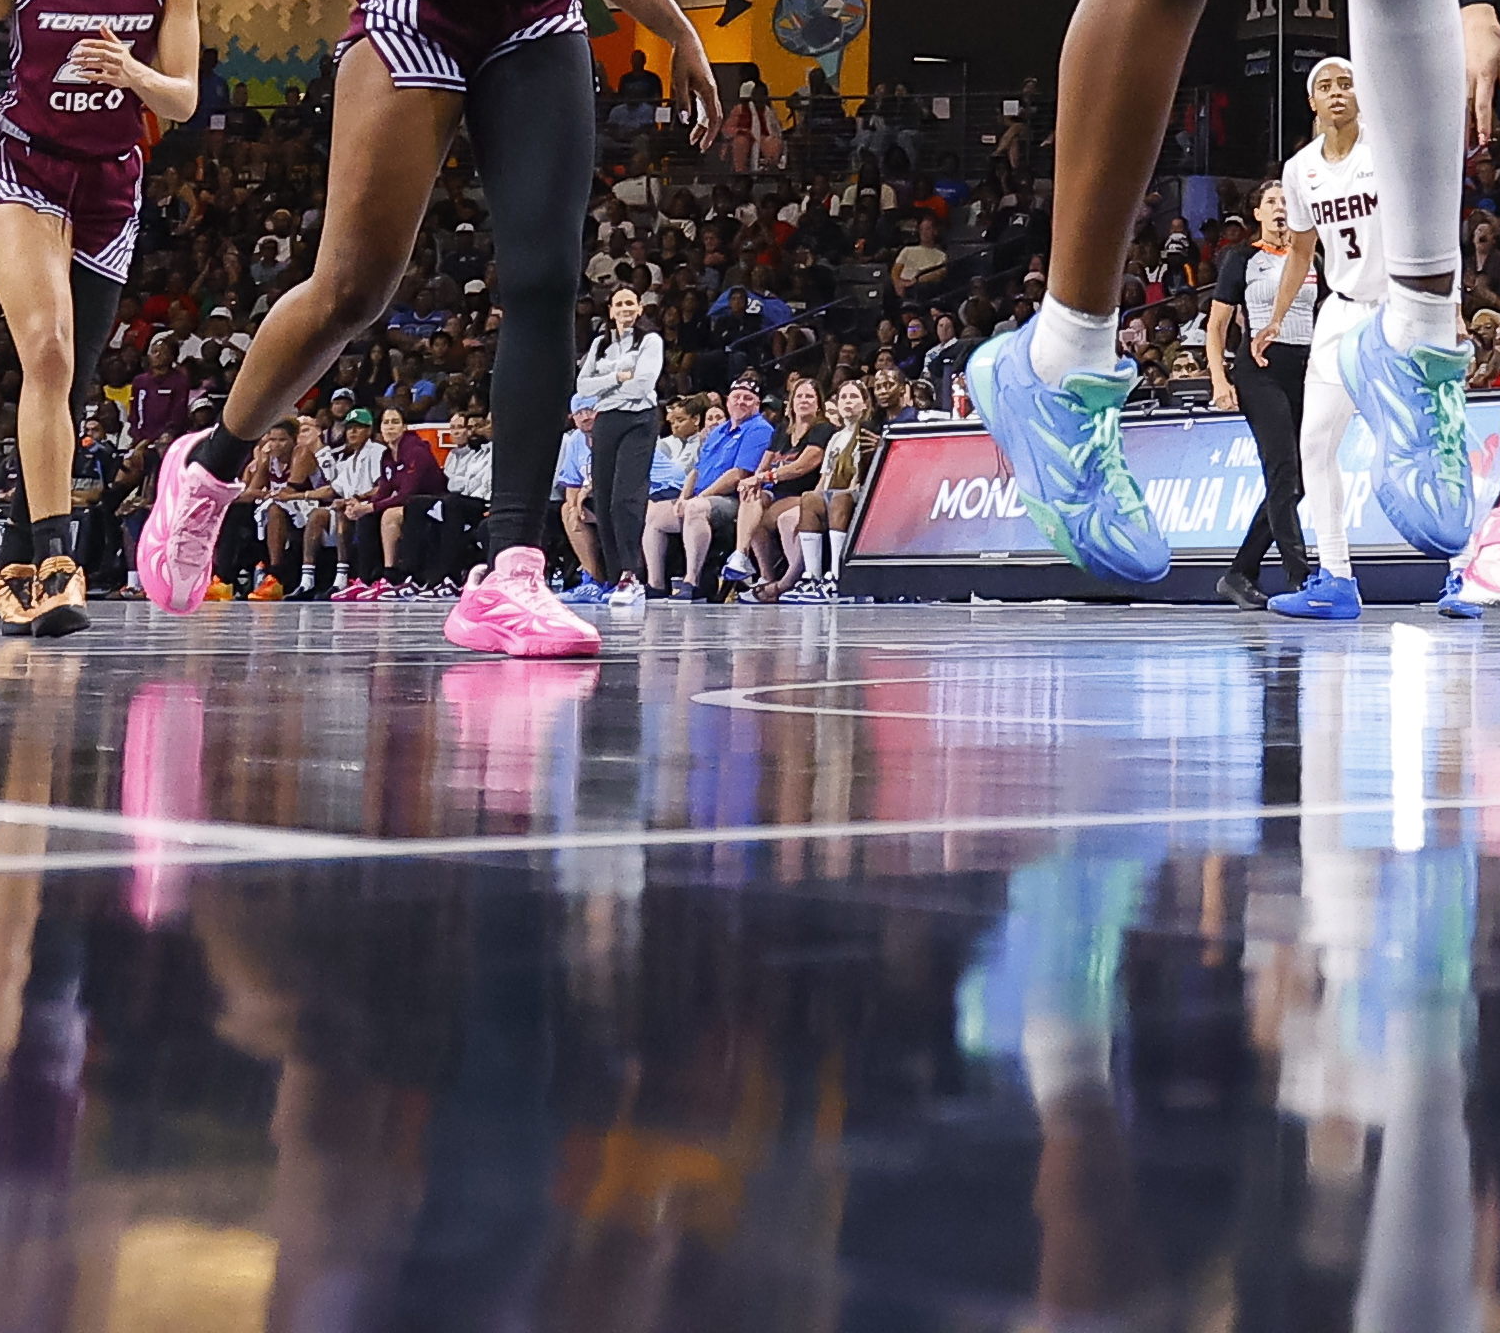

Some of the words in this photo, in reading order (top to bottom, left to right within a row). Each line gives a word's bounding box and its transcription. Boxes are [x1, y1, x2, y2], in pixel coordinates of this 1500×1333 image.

[37, 12, 155, 32] TORONTO
[49, 91, 105, 112] CIBC
[1310, 191, 1379, 226] DREAM
[1339, 225, 1363, 260] 3
[1144, 476, 1225, 533] NINJA
